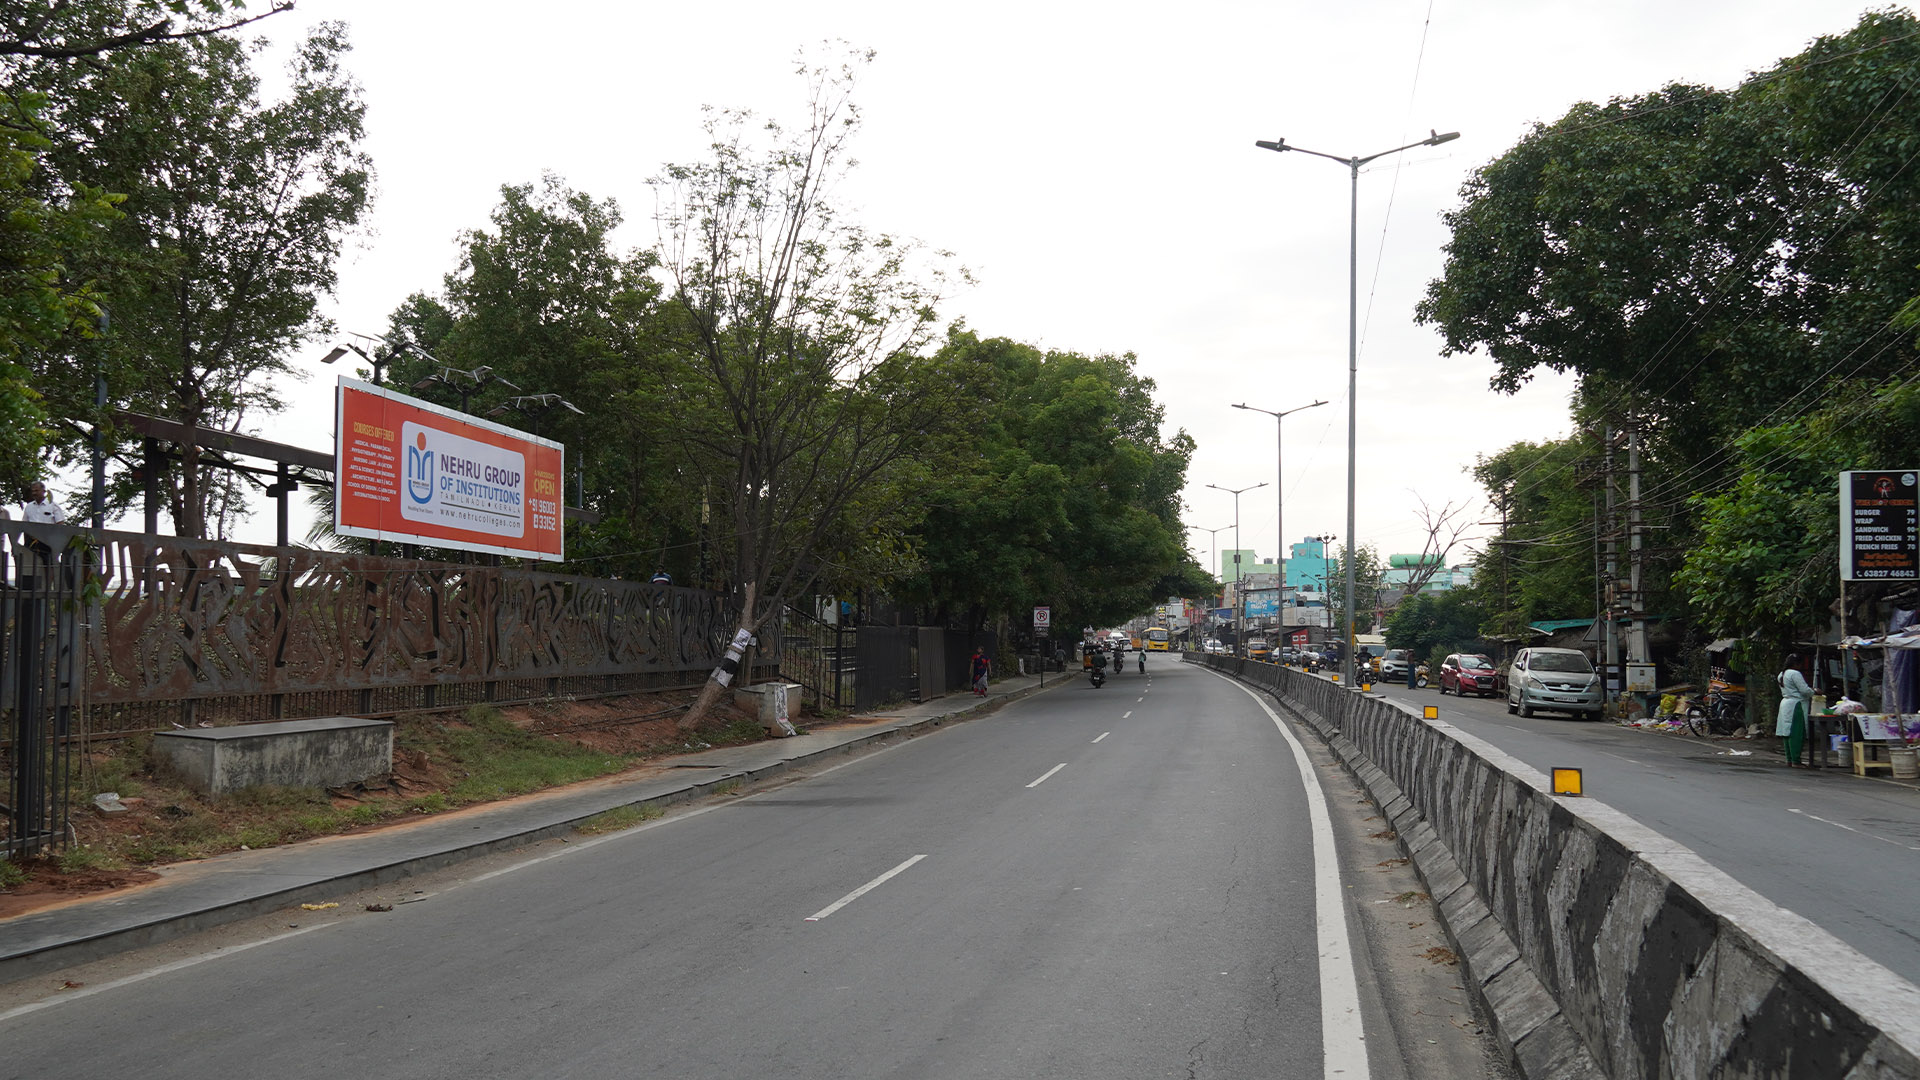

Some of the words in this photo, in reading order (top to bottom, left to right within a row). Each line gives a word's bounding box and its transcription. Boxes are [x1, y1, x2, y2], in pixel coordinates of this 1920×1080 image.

[353, 421, 375, 437] COURSES
[375, 427, 395, 442] OFFERED
[441, 453, 481, 480] NEHRU
[484, 465, 521, 488] GROUP
[440, 475, 454, 491] OF
[456, 479, 521, 506] INSTITUTIONS
[534, 478, 555, 496] OPEN
[538, 499, 556, 515] 96003
